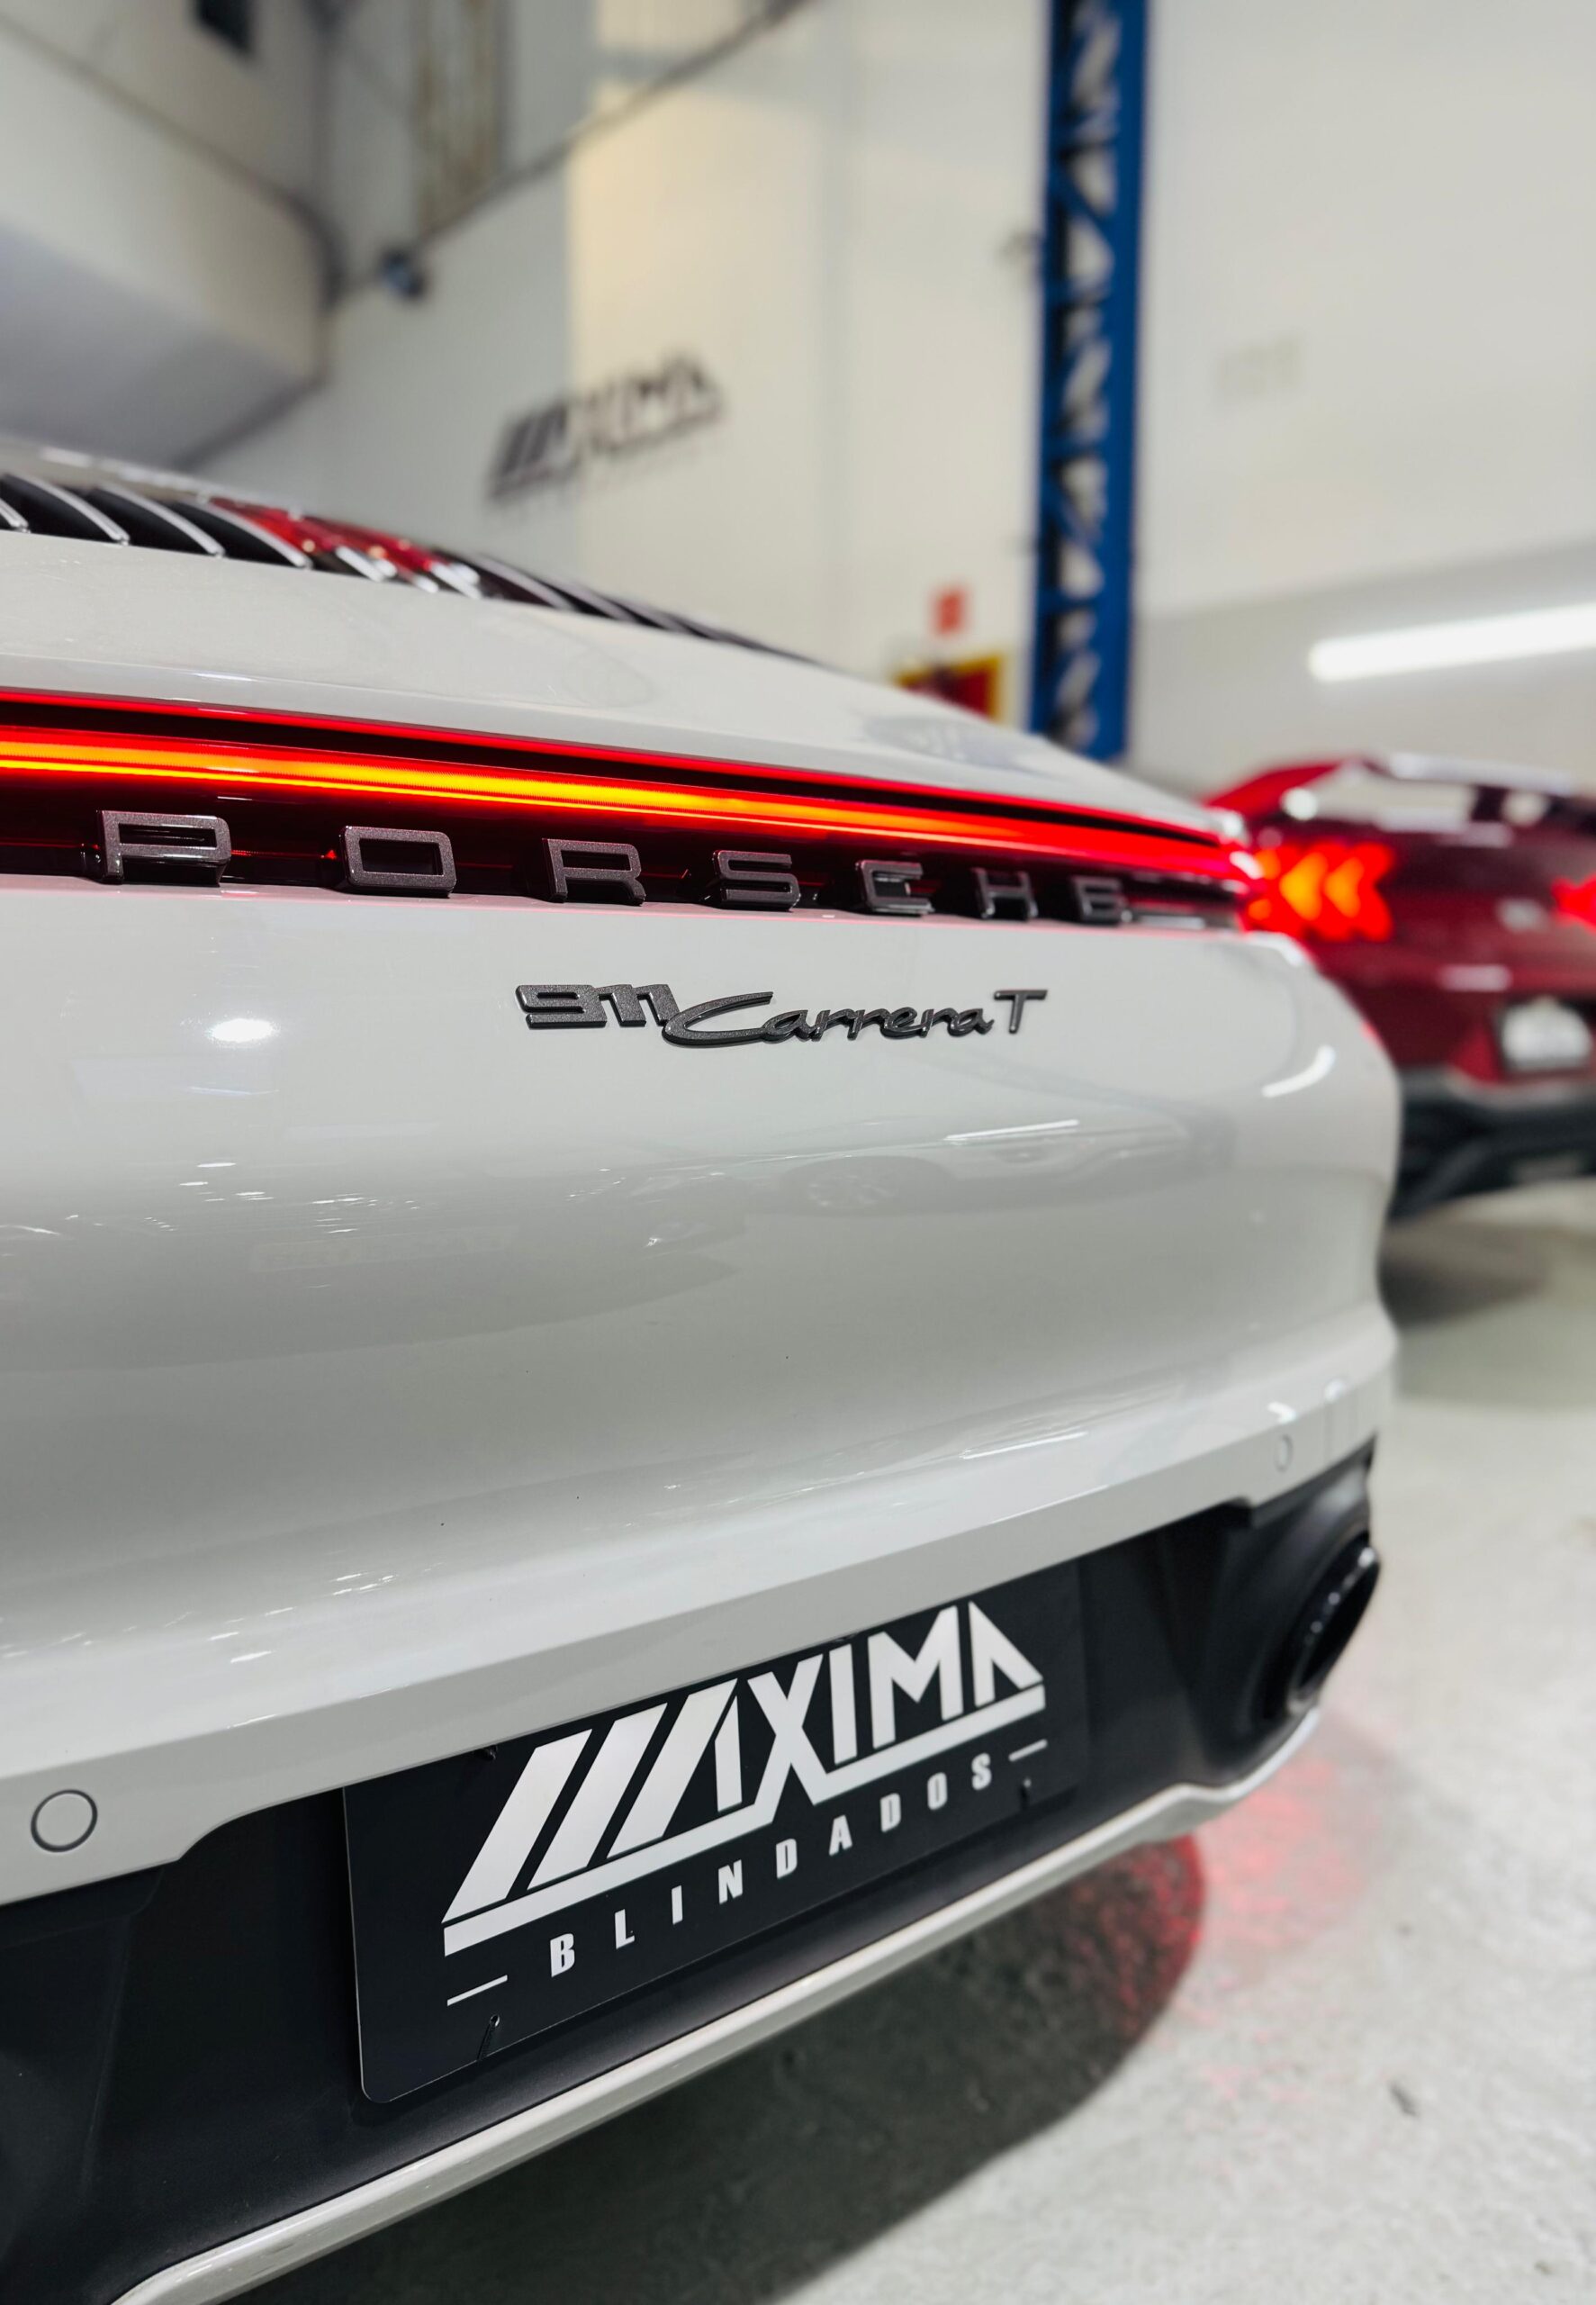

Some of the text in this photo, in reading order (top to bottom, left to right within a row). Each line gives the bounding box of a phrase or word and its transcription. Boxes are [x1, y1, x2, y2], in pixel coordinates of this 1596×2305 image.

[97, 809, 1128, 925] PORSCHE
[516, 983, 1048, 1049] 911 Carrera T
[441, 1601, 1046, 1957] MAXIMA
[549, 1752, 993, 1978] BLINDADOS
